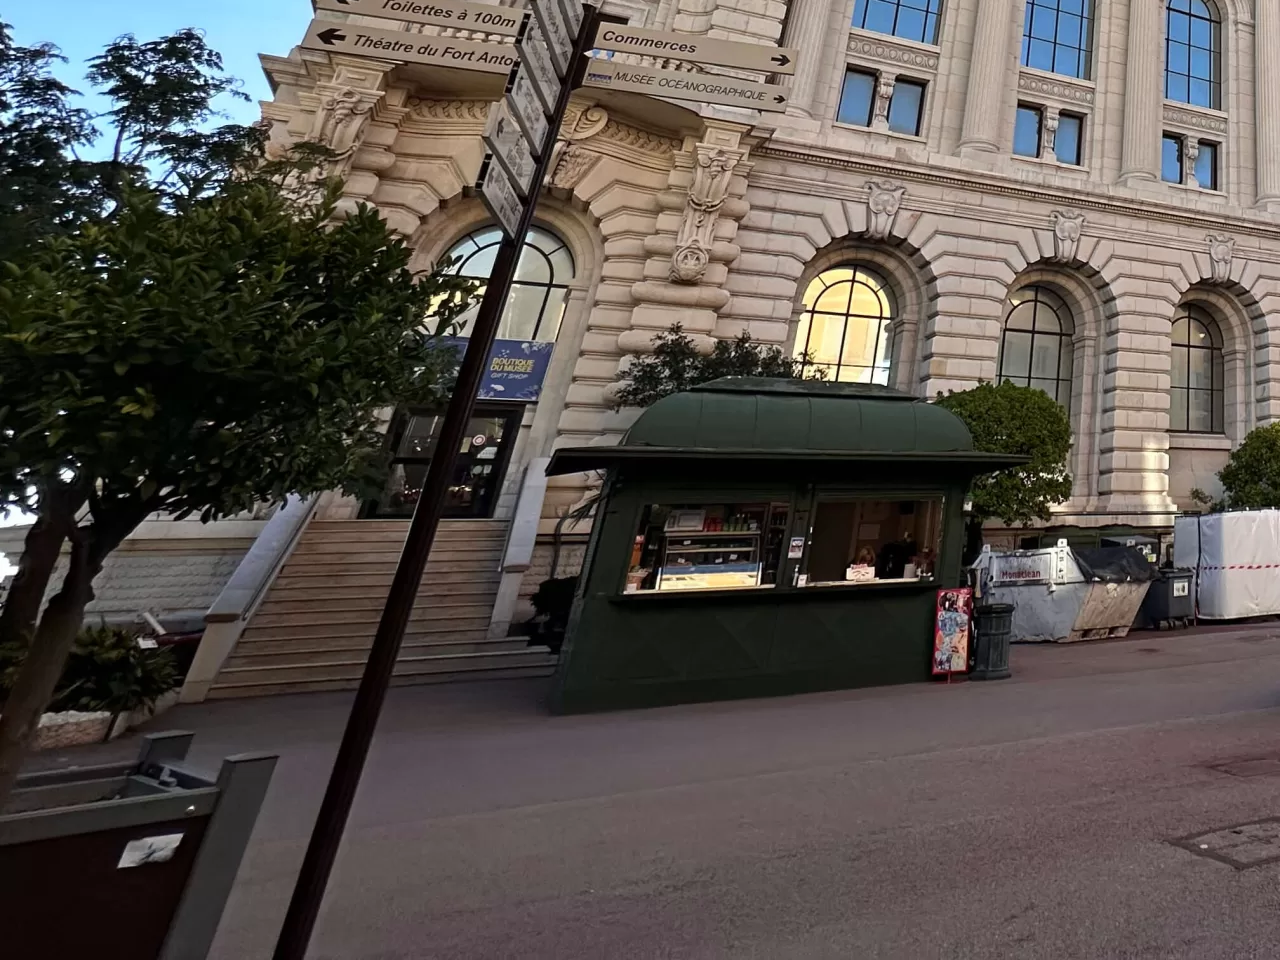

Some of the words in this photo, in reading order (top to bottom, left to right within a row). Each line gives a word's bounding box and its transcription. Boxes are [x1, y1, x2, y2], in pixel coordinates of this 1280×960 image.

[456, 8, 469, 21] à
[473, 11, 517, 28] 100m
[602, 30, 697, 54] Commerces
[417, 43, 440, 56] du
[441, 47, 476, 62] Fort
[476, 51, 517, 67] Anto
[613, 69, 657, 86] MUSÉE
[658, 77, 768, 102] OCÉANOGRAPHIQUE
[490, 364, 503, 372] DU
[493, 358, 535, 366] BOUTIQUE
